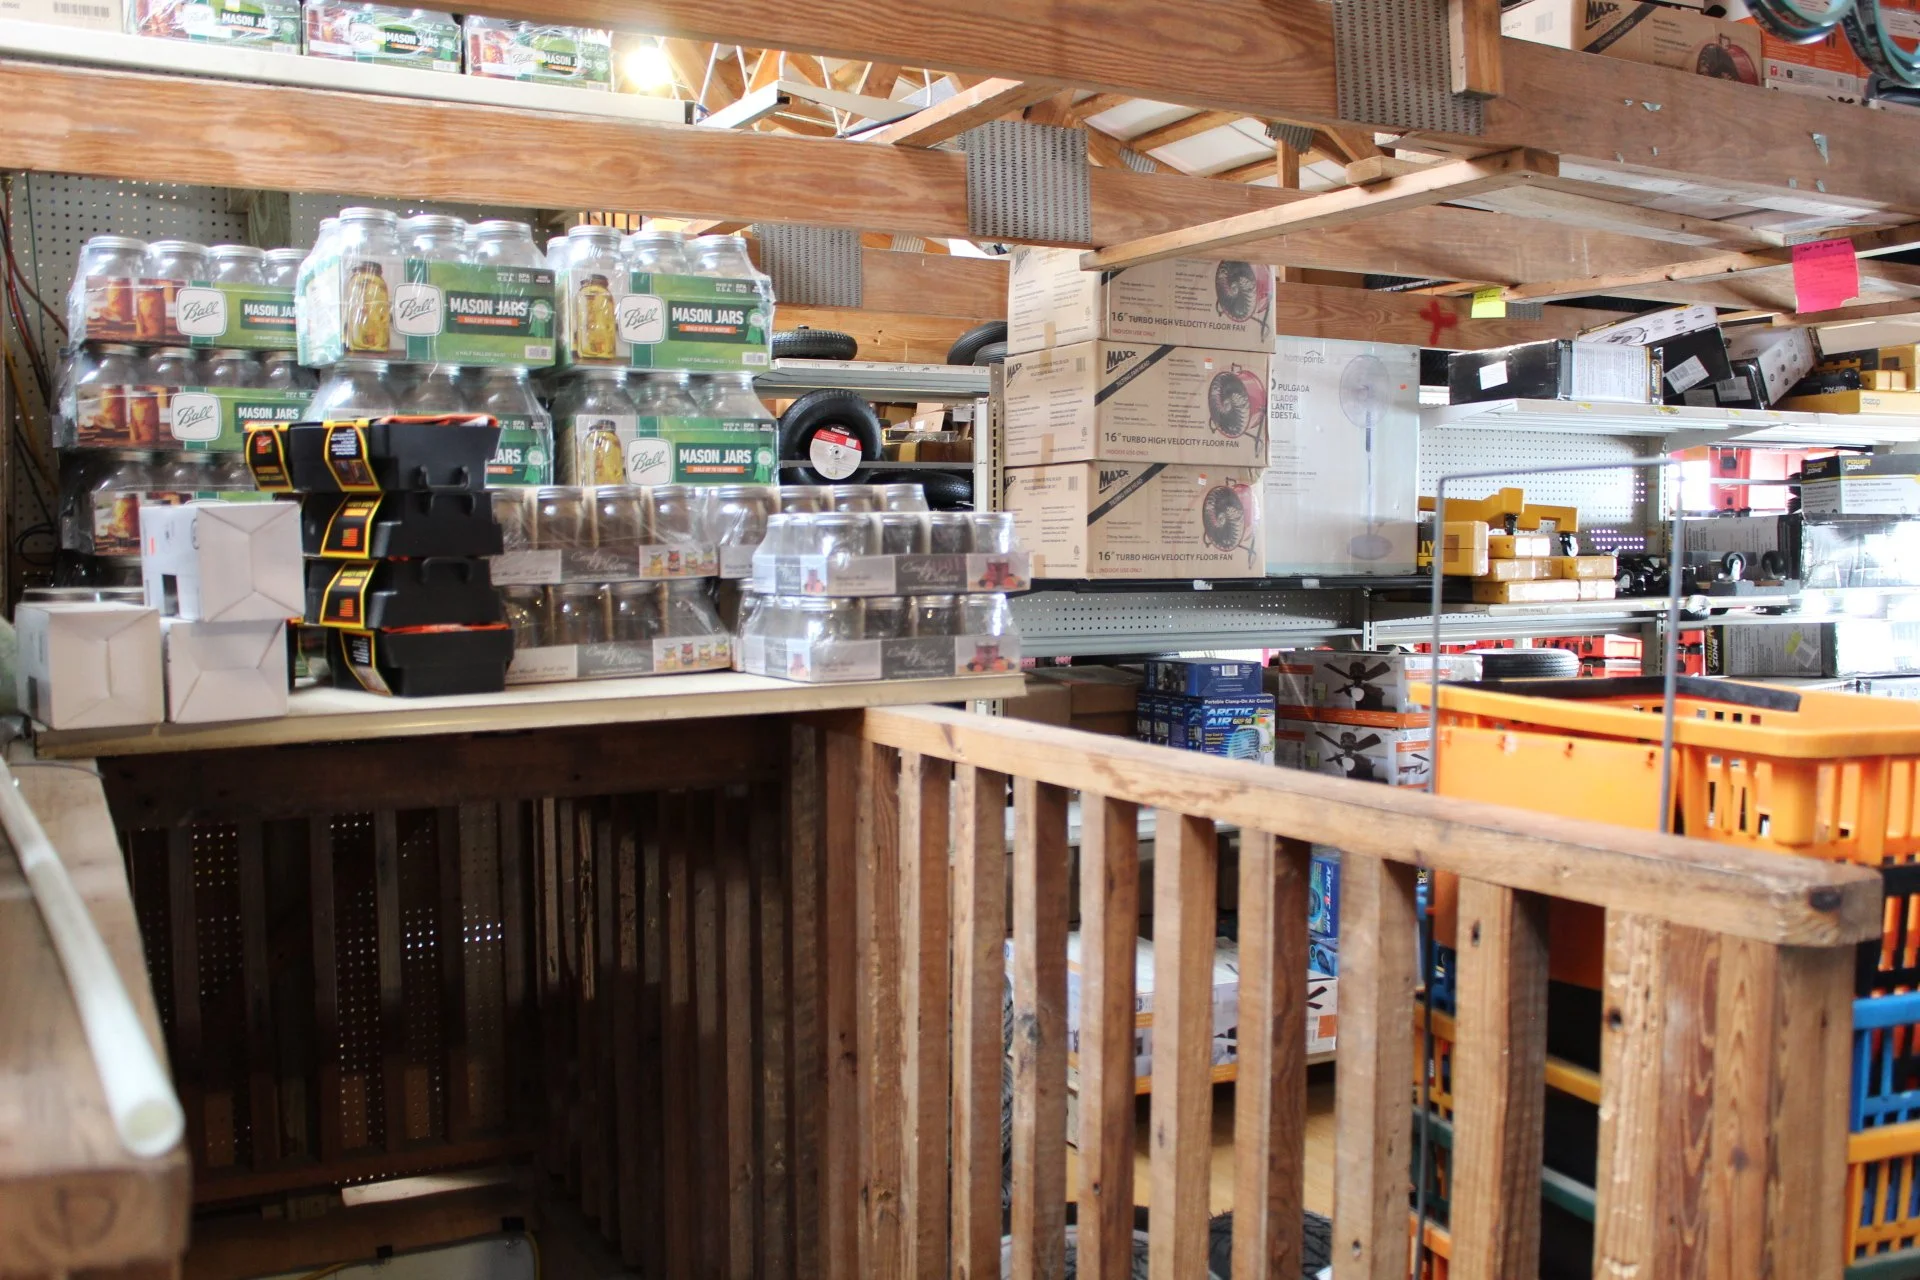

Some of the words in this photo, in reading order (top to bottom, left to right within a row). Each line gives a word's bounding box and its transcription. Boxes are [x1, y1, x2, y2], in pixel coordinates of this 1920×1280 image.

[221, 12, 254, 28] MASON
[386, 32, 417, 45] MASON
[183, 300, 220, 323] Ball
[244, 304, 278, 316] MASON
[281, 305, 297, 318] JAR
[400, 298, 437, 320] Ball
[450, 297, 493, 314] MASON
[495, 300, 528, 317] JARS
[624, 307, 660, 330] Ball
[672, 307, 713, 323] MASON
[715, 309, 744, 325] JARS
[1129, 315, 1153, 325] TURBO
[1155, 317, 1173, 326] HIGH
[1175, 319, 1207, 328] VELOCITY
[1209, 322, 1231, 331] FLOOR
[1232, 323, 1246, 332] FAN
[1278, 384, 1310, 392] PULGADA
[238, 407, 272, 419] MASON
[274, 408, 299, 420] JARS
[1271, 403, 1293, 411] LANTE
[1271, 411, 1302, 419] EDESTAL
[177, 405, 215, 427] Ball
[1122, 435, 1147, 444] TURBO
[1148, 436, 1166, 445] HIGH
[1167, 437, 1201, 446] VELOCITY
[1202, 439, 1224, 447] FLOOR
[1226, 440, 1240, 448] FAN
[490, 448, 521, 464] ARS
[632, 450, 666, 473] Ball
[679, 449, 720, 464] MASON
[722, 449, 752, 465] JARS
[1116, 553, 1140, 561] TURBO
[1142, 553, 1160, 561] HIGH
[1161, 553, 1195, 561] VELOCITY
[1196, 553, 1218, 561] FLOOR
[1207, 707, 1254, 717] ARCTIC
[1206, 717, 1233, 726] AIR
